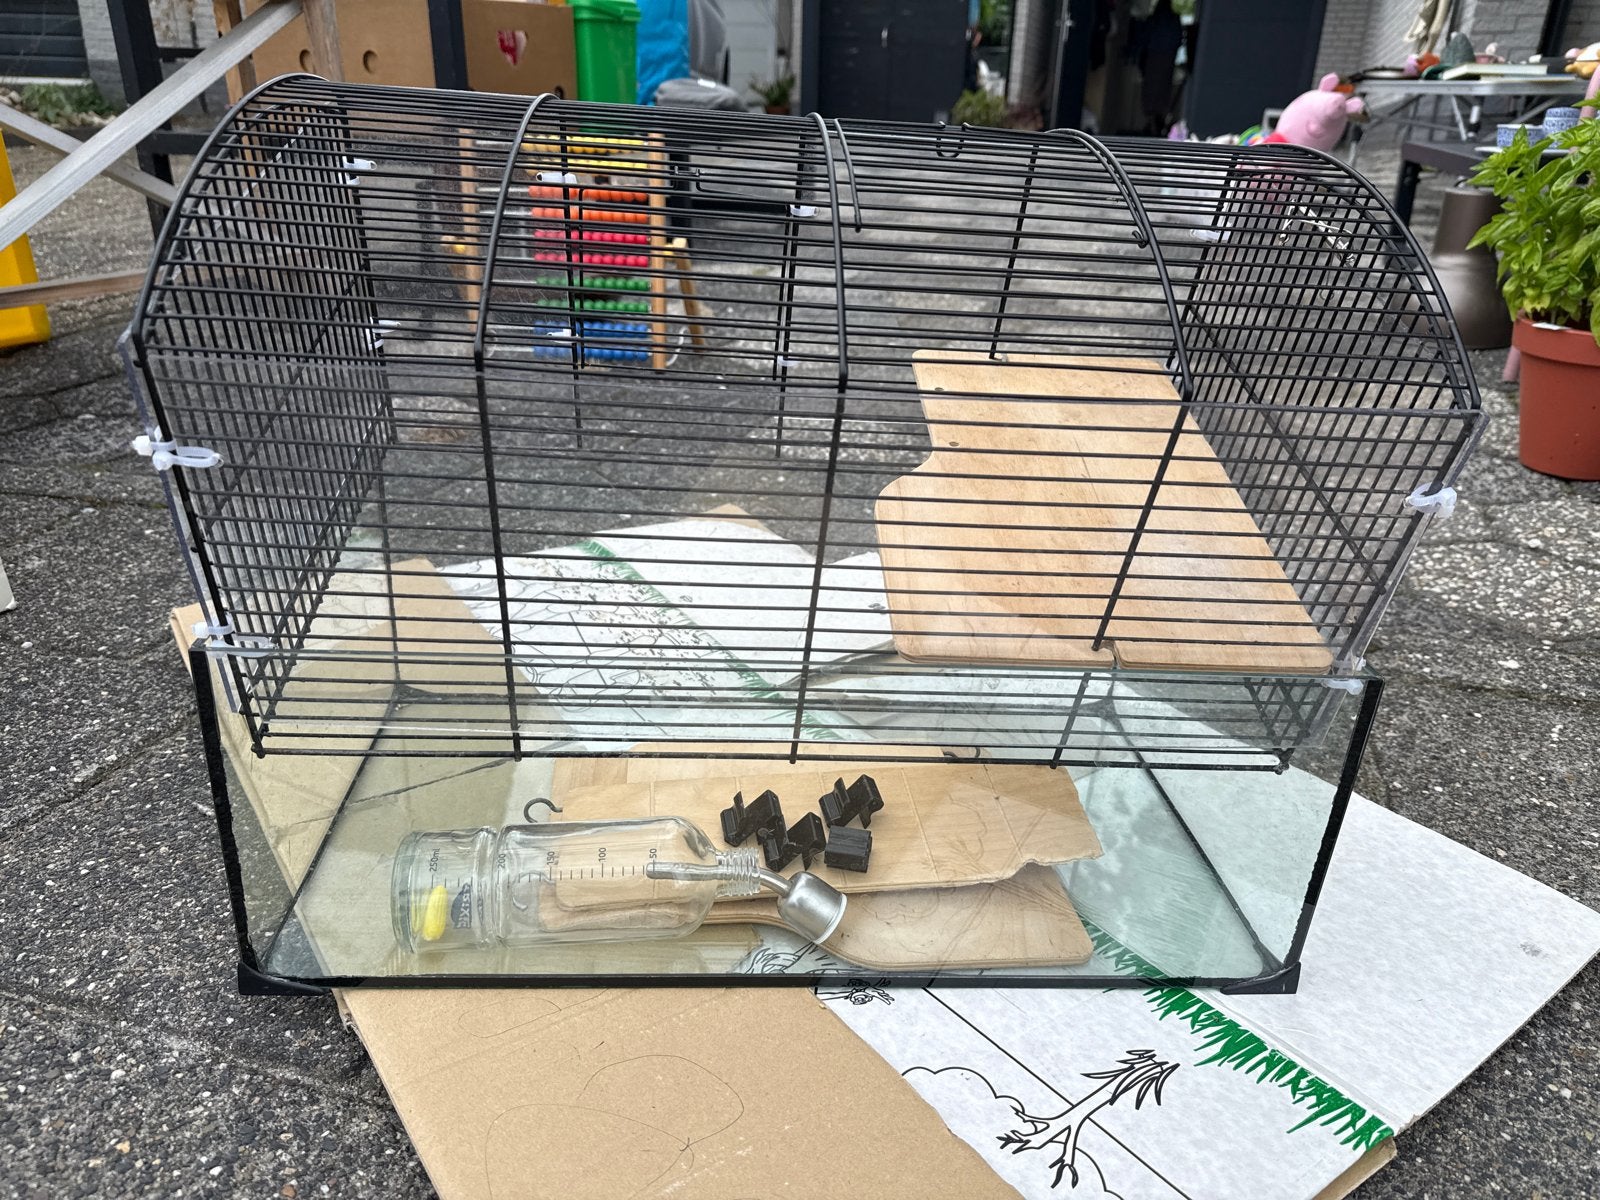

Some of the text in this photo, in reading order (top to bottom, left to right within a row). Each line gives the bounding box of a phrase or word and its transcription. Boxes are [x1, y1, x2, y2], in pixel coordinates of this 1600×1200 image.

[429, 848, 441, 872] 250ml
[497, 853, 507, 869] 200
[546, 851, 556, 866] 150
[598, 847, 607, 862] 100
[649, 848, 658, 859] 50
